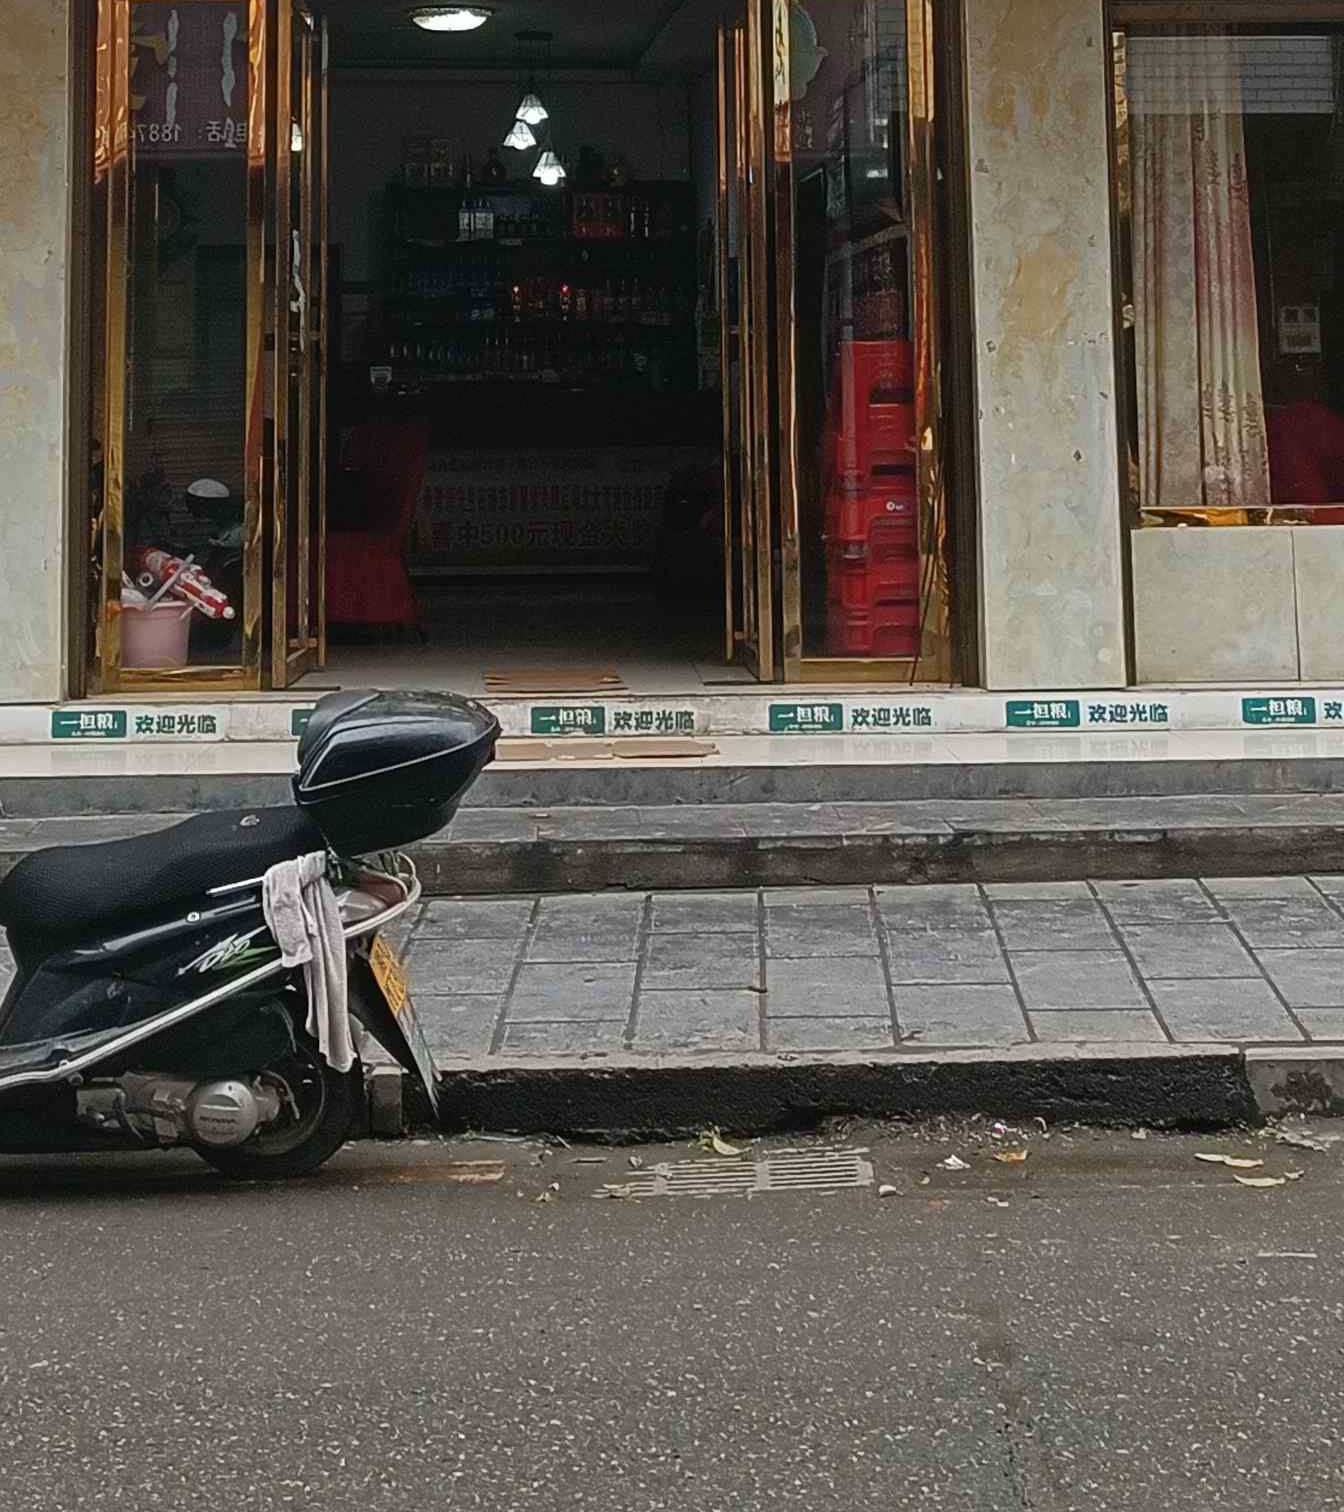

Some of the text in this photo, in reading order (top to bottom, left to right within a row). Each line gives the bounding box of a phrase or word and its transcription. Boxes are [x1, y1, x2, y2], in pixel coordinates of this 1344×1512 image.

[613, 709, 695, 731] 欢迎光临
[850, 706, 932, 727] 欢迎光临
[1087, 702, 1169, 723] 欢迎光临
[135, 713, 217, 734] 欢迎光临
